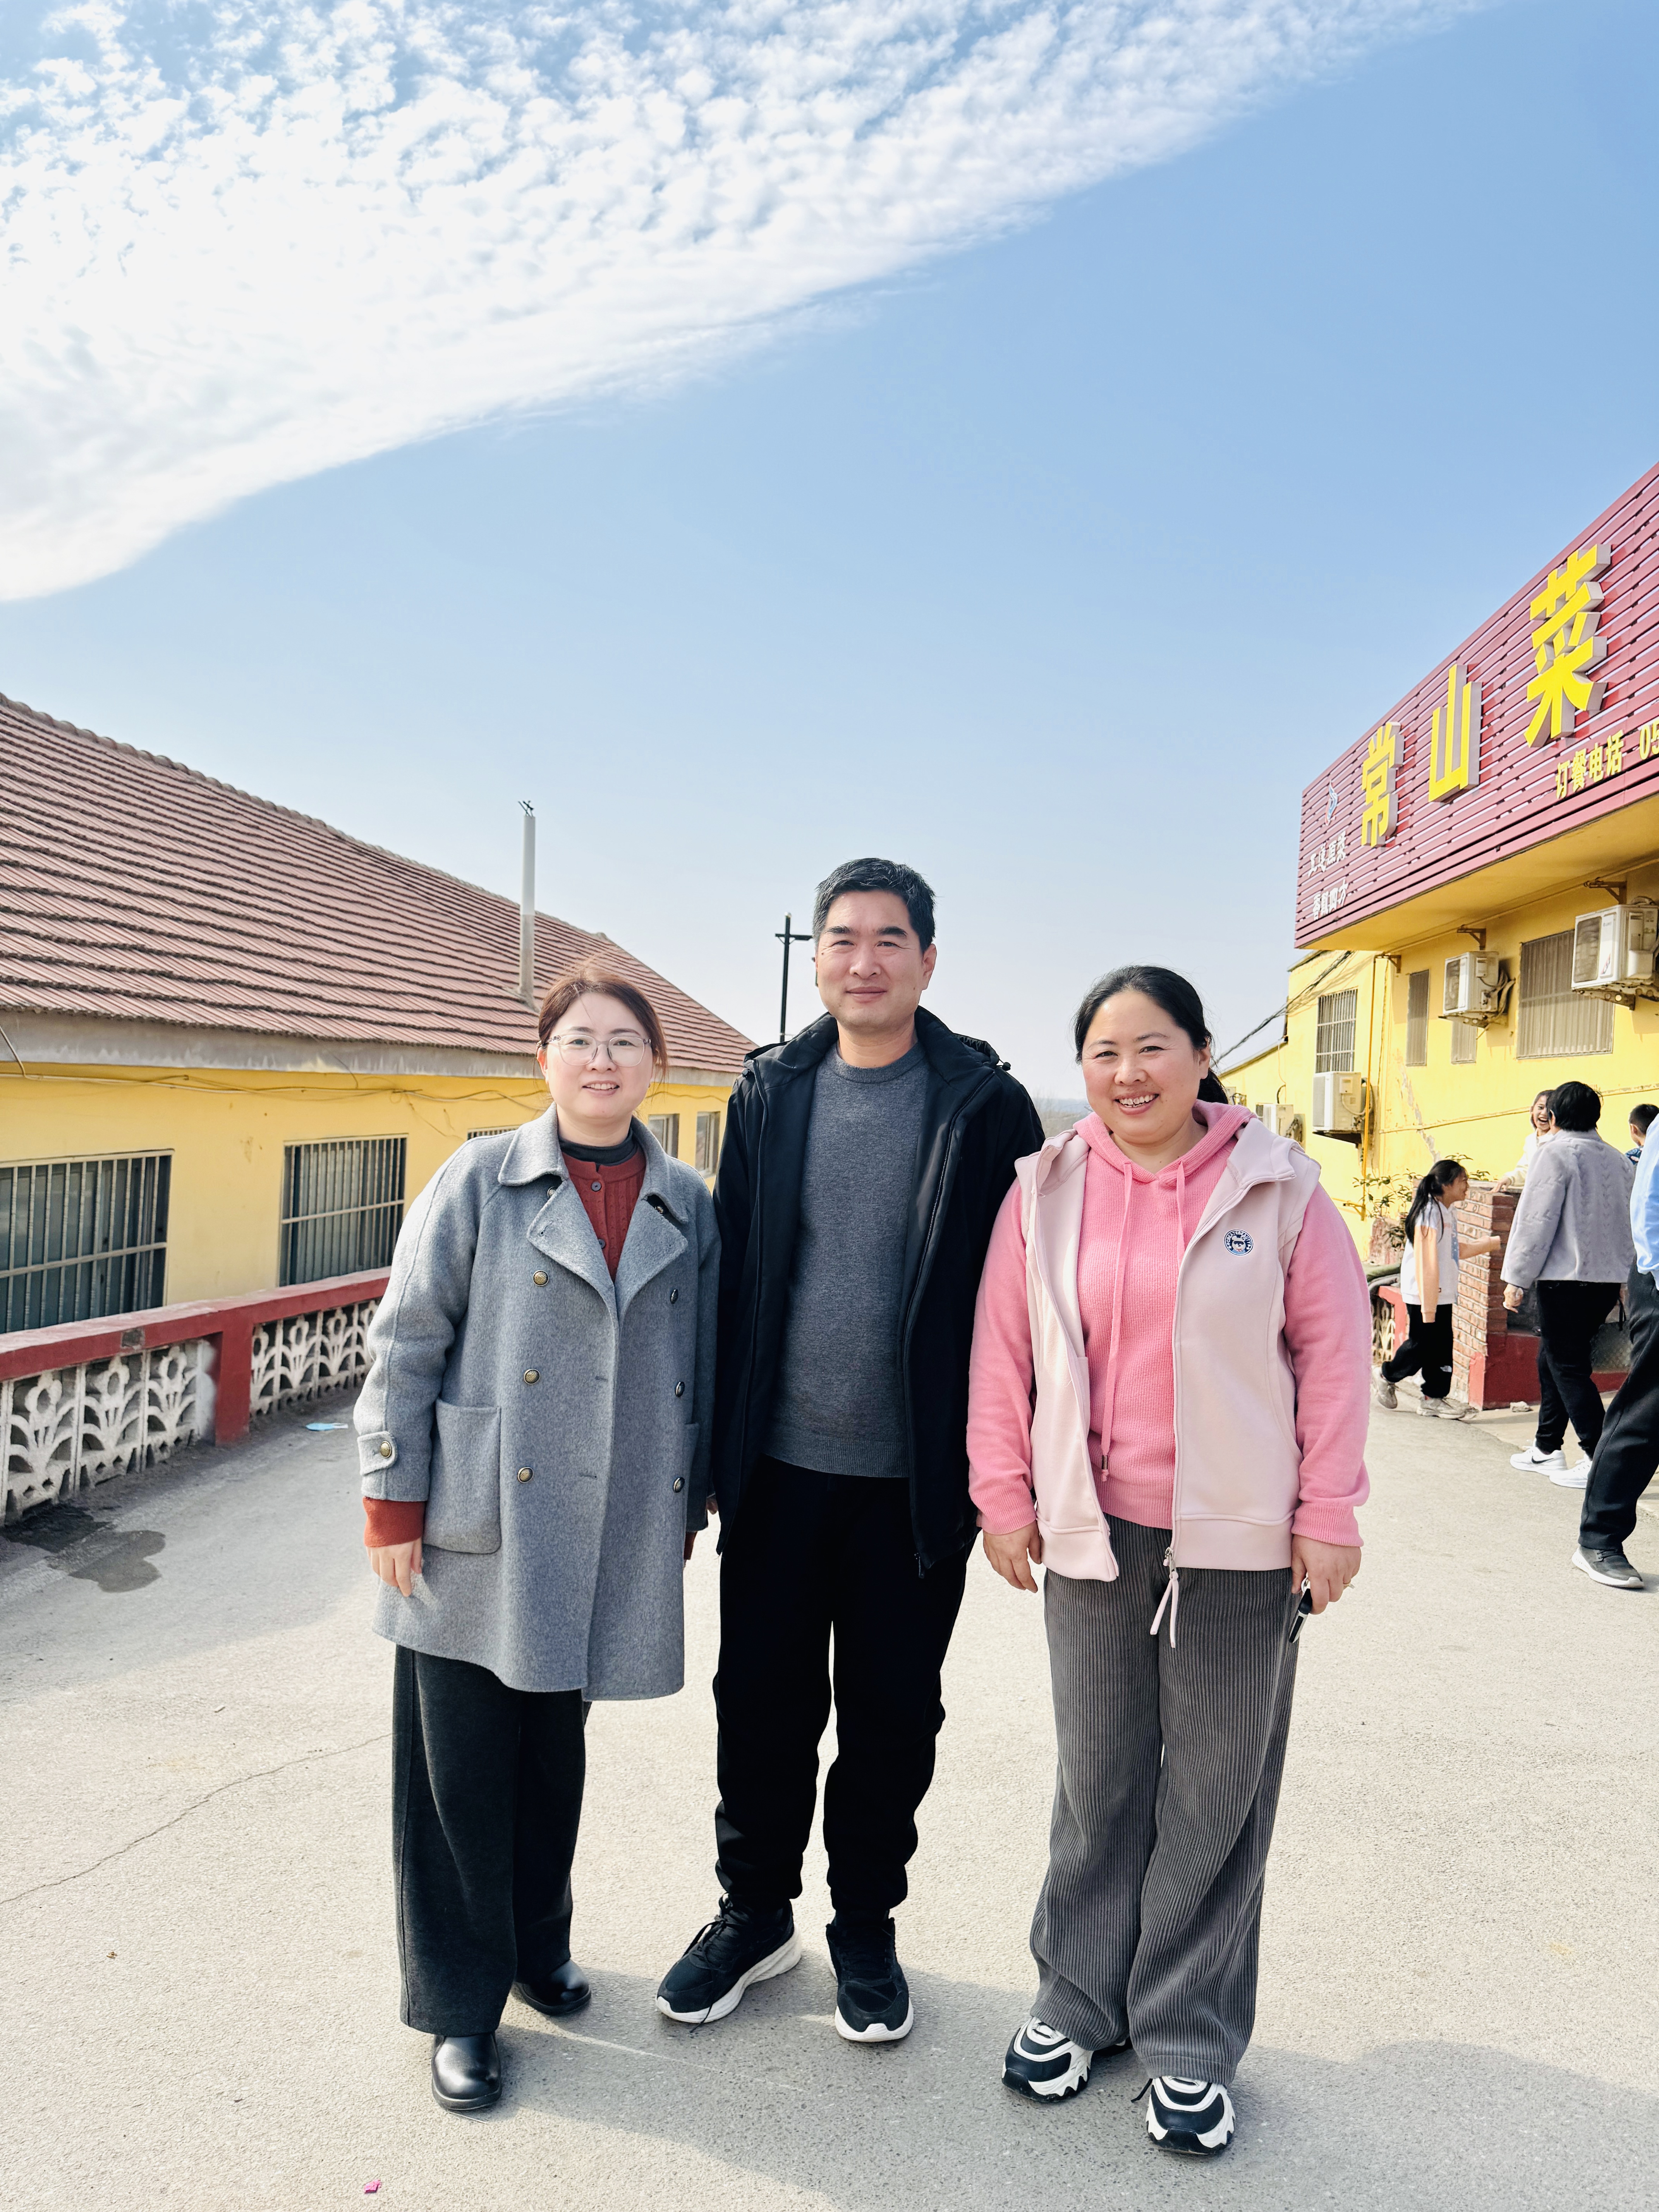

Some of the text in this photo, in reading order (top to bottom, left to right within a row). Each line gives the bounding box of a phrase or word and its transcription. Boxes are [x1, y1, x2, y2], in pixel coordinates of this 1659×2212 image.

[1362, 544, 1608, 847] 常山菜
[1555, 729, 1624, 799] 订餐电话
